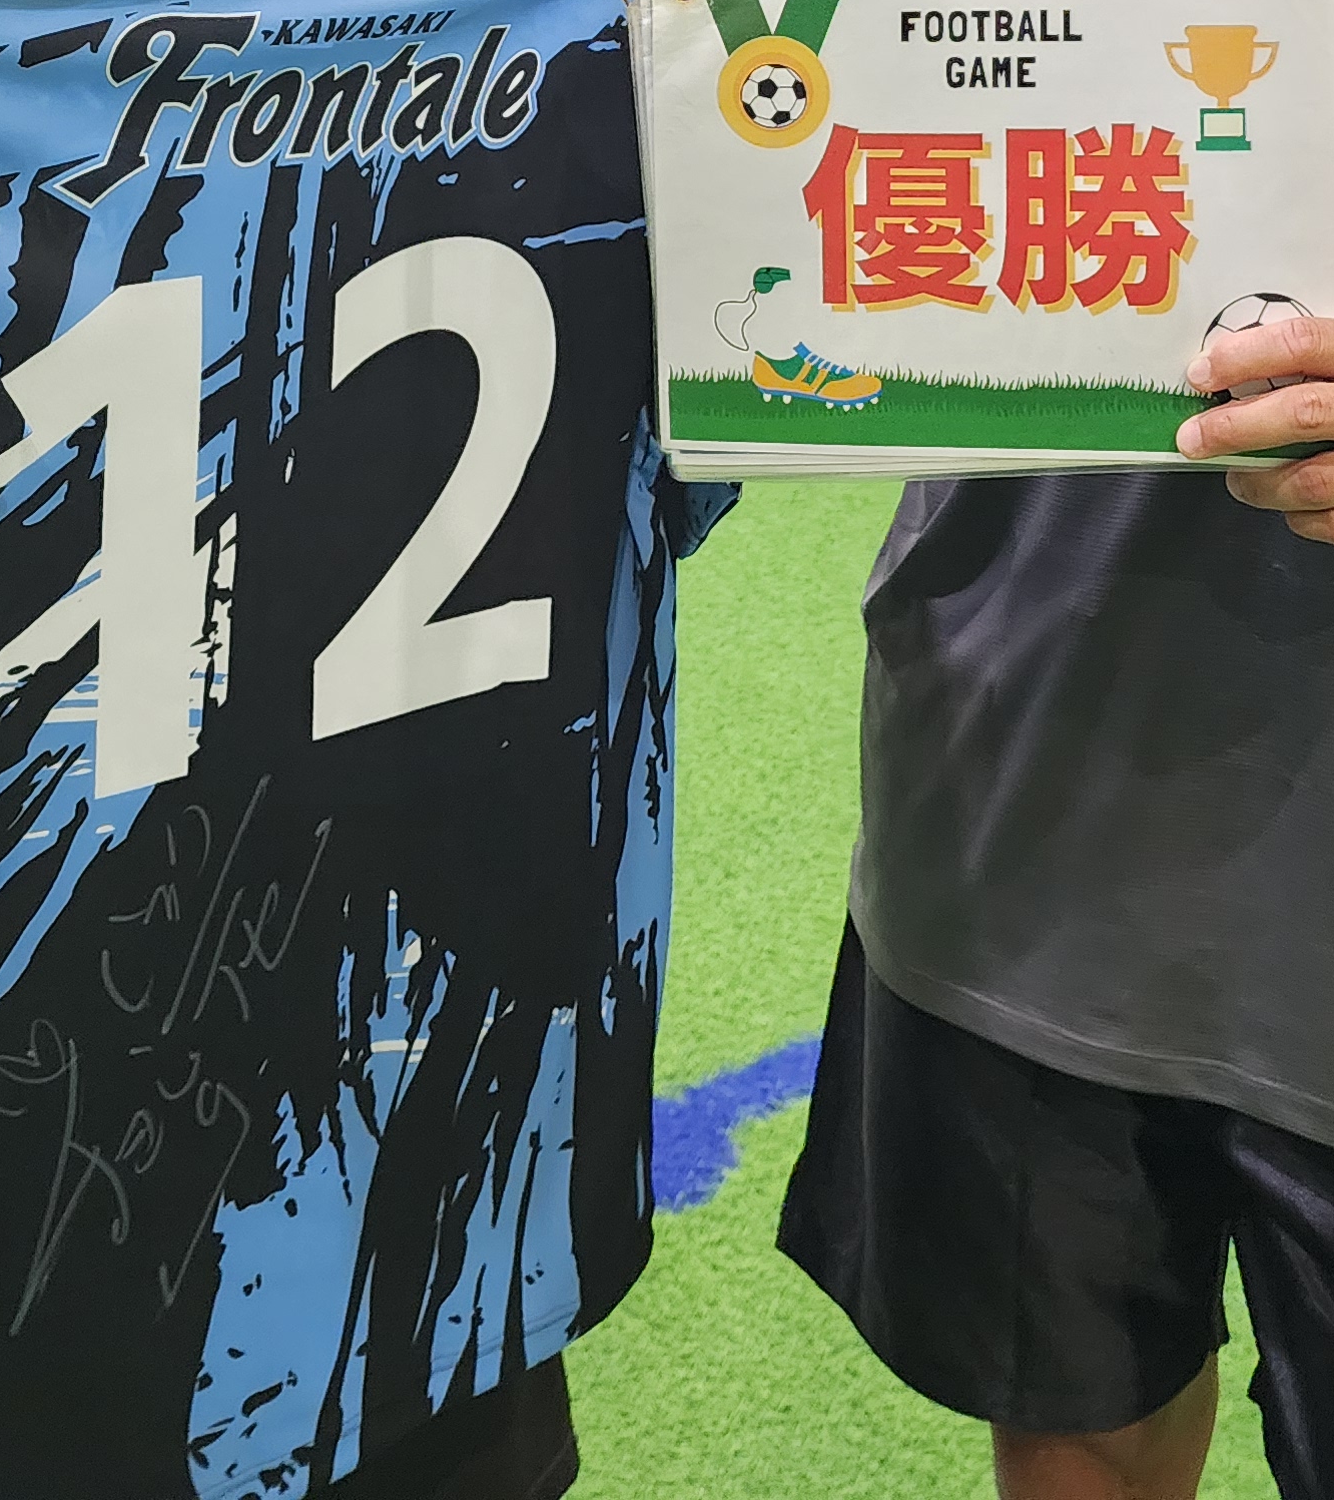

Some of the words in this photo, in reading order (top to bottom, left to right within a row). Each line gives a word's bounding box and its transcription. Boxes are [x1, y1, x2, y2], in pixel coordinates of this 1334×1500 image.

[269, 9, 456, 47] KAWASAKI
[900, 10, 1083, 43] FOOTBALL
[945, 56, 1037, 89] GAME
[53, 11, 542, 209] Frontale
[802, 122, 1199, 315] 優勝
